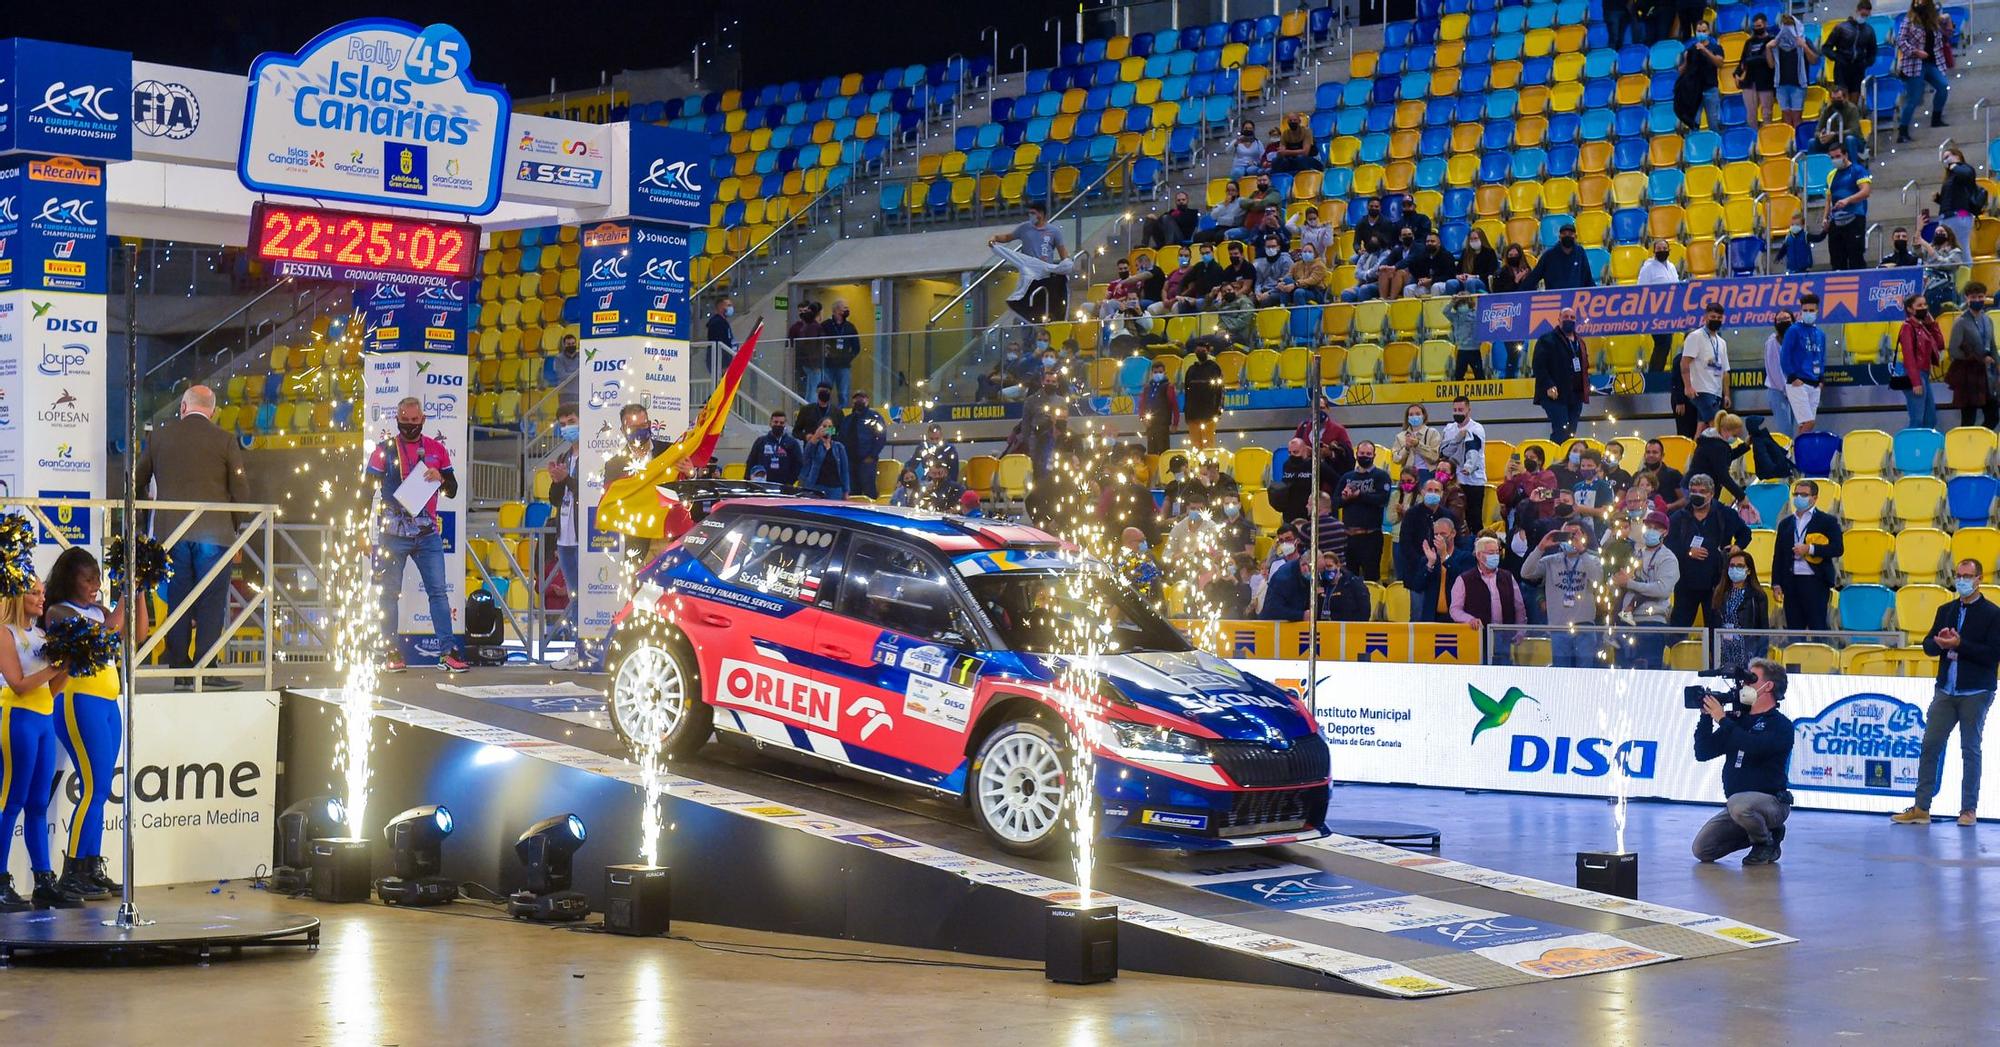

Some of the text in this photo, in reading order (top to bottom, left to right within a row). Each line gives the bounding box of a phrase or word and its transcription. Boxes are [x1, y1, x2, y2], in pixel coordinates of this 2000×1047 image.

[348, 36, 400, 72] Rally
[407, 37, 459, 79] 45
[329, 61, 412, 105] Islas
[29, 115, 118, 132] FIA EUROPEAN RALLY
[294, 86, 469, 145] Canarias
[44, 126, 117, 140] CHAMPIONSHIP
[268, 153, 309, 166] Canarias
[288, 147, 308, 157] Islas
[43, 165, 87, 180] Recalvi
[649, 196, 700, 207] CHAMPIONSHIP
[650, 189, 681, 198] EUROPEAN
[683, 192, 701, 200] RALLY
[42, 230, 96, 239] CHAMPIONSHIP
[262, 213, 464, 273] 22:25:02
[646, 233, 687, 246] SONOCOM
[282, 262, 448, 287] FESTINA CRONOMETRADOR OFICIAL
[1573, 277, 1815, 318] Recalvi Canarias
[1869, 279, 1915, 301] Recalvi
[1482, 303, 1521, 322] Recalvi
[1576, 313, 1740, 334] ompromiso y Servicio el
[661, 348, 678, 357] OLSEN
[645, 373, 677, 383] BALEARIA
[1436, 382, 1504, 399] GRAN CANARIA
[38, 411, 89, 423] LOPESAN
[952, 405, 1005, 420] GRAN CANARIA
[38, 459, 91, 469] GranCanaria
[673, 578, 716, 595] VOLKSWAGEN
[716, 588, 751, 603] FINANCIAL
[751, 597, 783, 612] SERVICES
[959, 658, 975, 685] 1
[727, 667, 832, 722] ORLEN
[1360, 707, 1411, 722] Municipal
[1328, 722, 1375, 736] Deportes
[1833, 717, 1885, 739] Islas
[1377, 739, 1402, 747] Canaria
[1812, 731, 1921, 758] Canarias
[142, 809, 259, 829] Cabrera Medina
